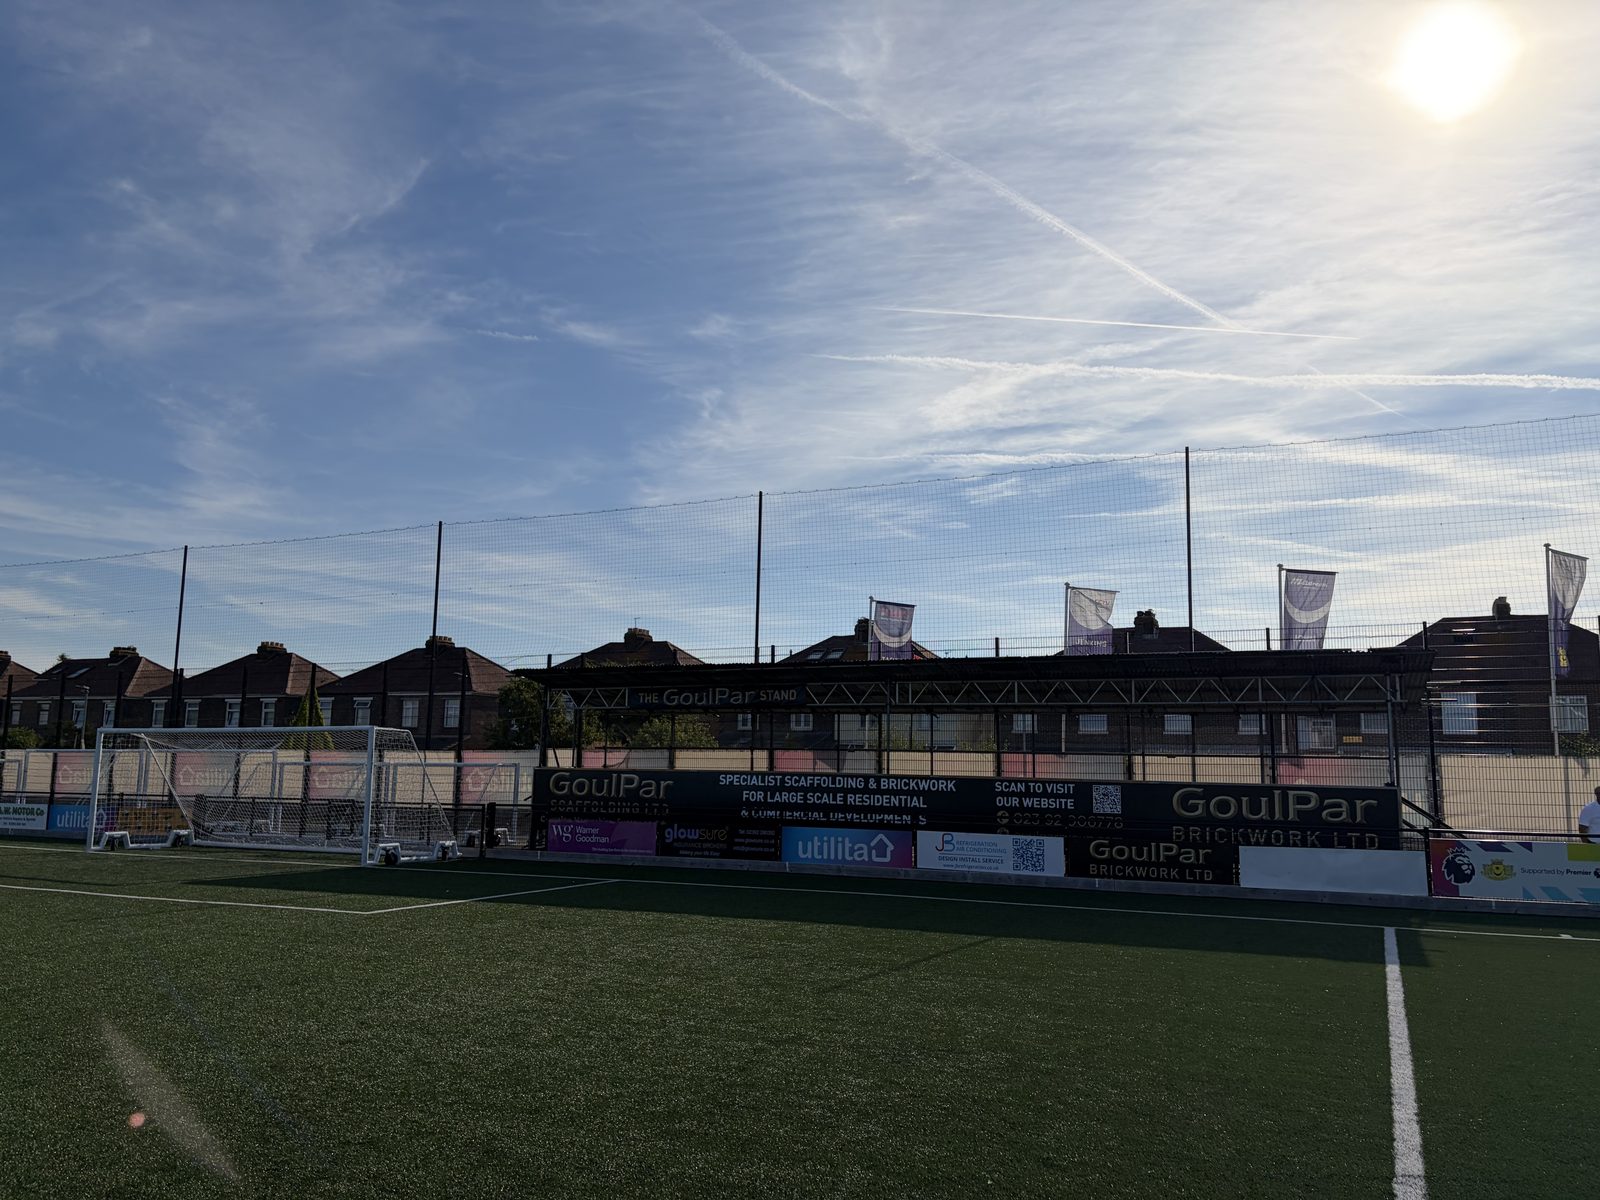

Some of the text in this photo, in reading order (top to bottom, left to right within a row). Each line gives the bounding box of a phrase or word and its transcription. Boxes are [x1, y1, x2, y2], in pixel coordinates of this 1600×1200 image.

[638, 688, 797, 706] THE GoulPar STAND
[548, 771, 675, 800] GoulPar
[719, 774, 957, 793] SPECIALIST SCAFFOLDING & BRICKWORK
[994, 781, 1075, 795] SCAN TO VISIT
[550, 800, 640, 814] SCAFFOLDING
[742, 790, 928, 808] FOR LARGE SCALE RESIDENTIAL
[995, 796, 1075, 810] OUR WEBSITE
[1172, 787, 1378, 824] GoulPar
[829, 811, 928, 825] DEVELOPMENS
[575, 825, 600, 834] Warner
[575, 834, 610, 843] Goodman
[664, 823, 728, 843] glowsure
[1172, 826, 1380, 850] BRICKWORK LTD
[797, 836, 869, 861] utilita
[1089, 839, 1213, 865] GoulPar
[1089, 864, 1213, 881] BRICKWORK LTD
[1520, 867, 1592, 876] Supported by Premier
